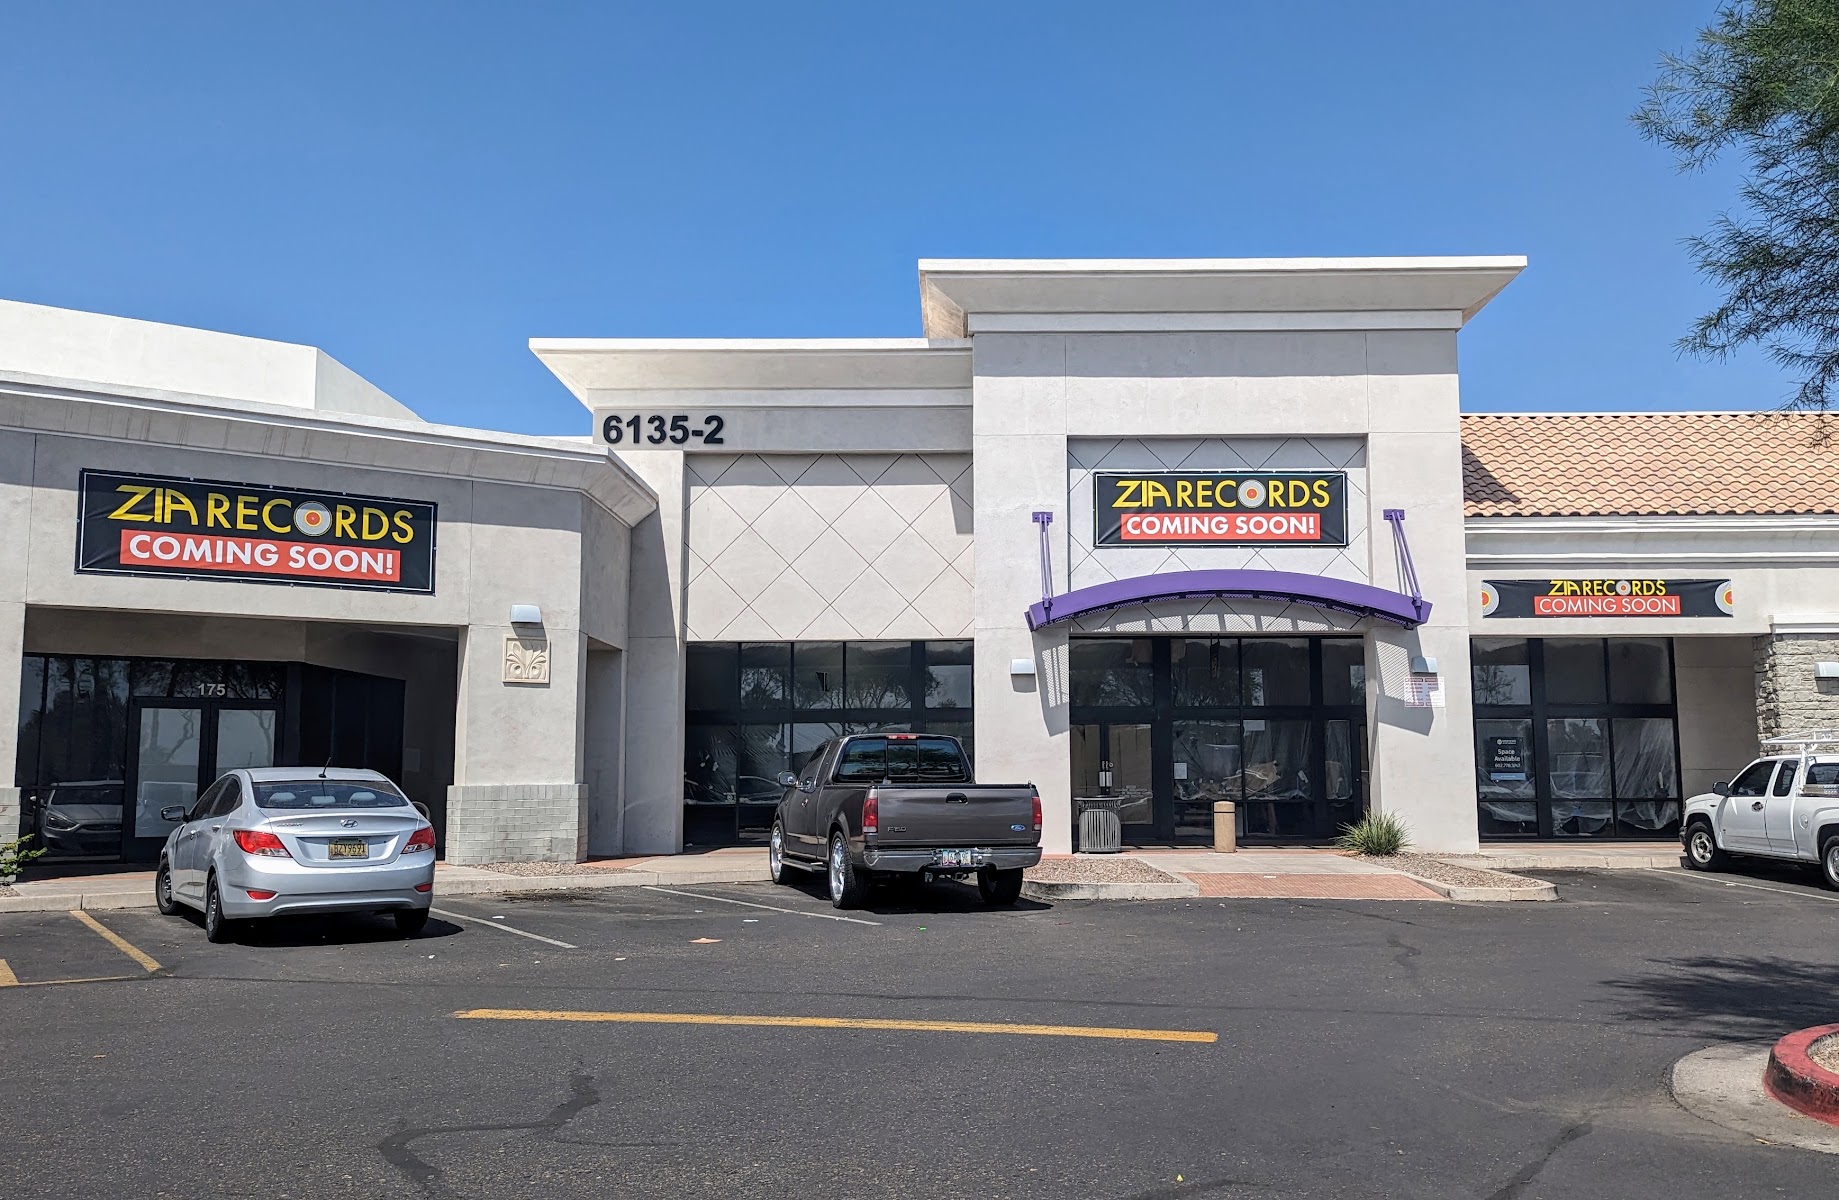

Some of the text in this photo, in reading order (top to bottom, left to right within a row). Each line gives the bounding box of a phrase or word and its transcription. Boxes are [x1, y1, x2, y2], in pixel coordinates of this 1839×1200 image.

[603, 415, 724, 444] 6135-2
[1112, 479, 1330, 508] ZIA RECORDS
[107, 484, 414, 544] ZIA RECORDS
[1126, 516, 1315, 535] COMING SOON!
[129, 534, 393, 576] COMING SOON!
[1548, 580, 1666, 596] ZIA RECORDS
[1539, 598, 1676, 613] COMING SOON
[197, 683, 226, 696] 175
[1497, 748, 1516, 756] Space
